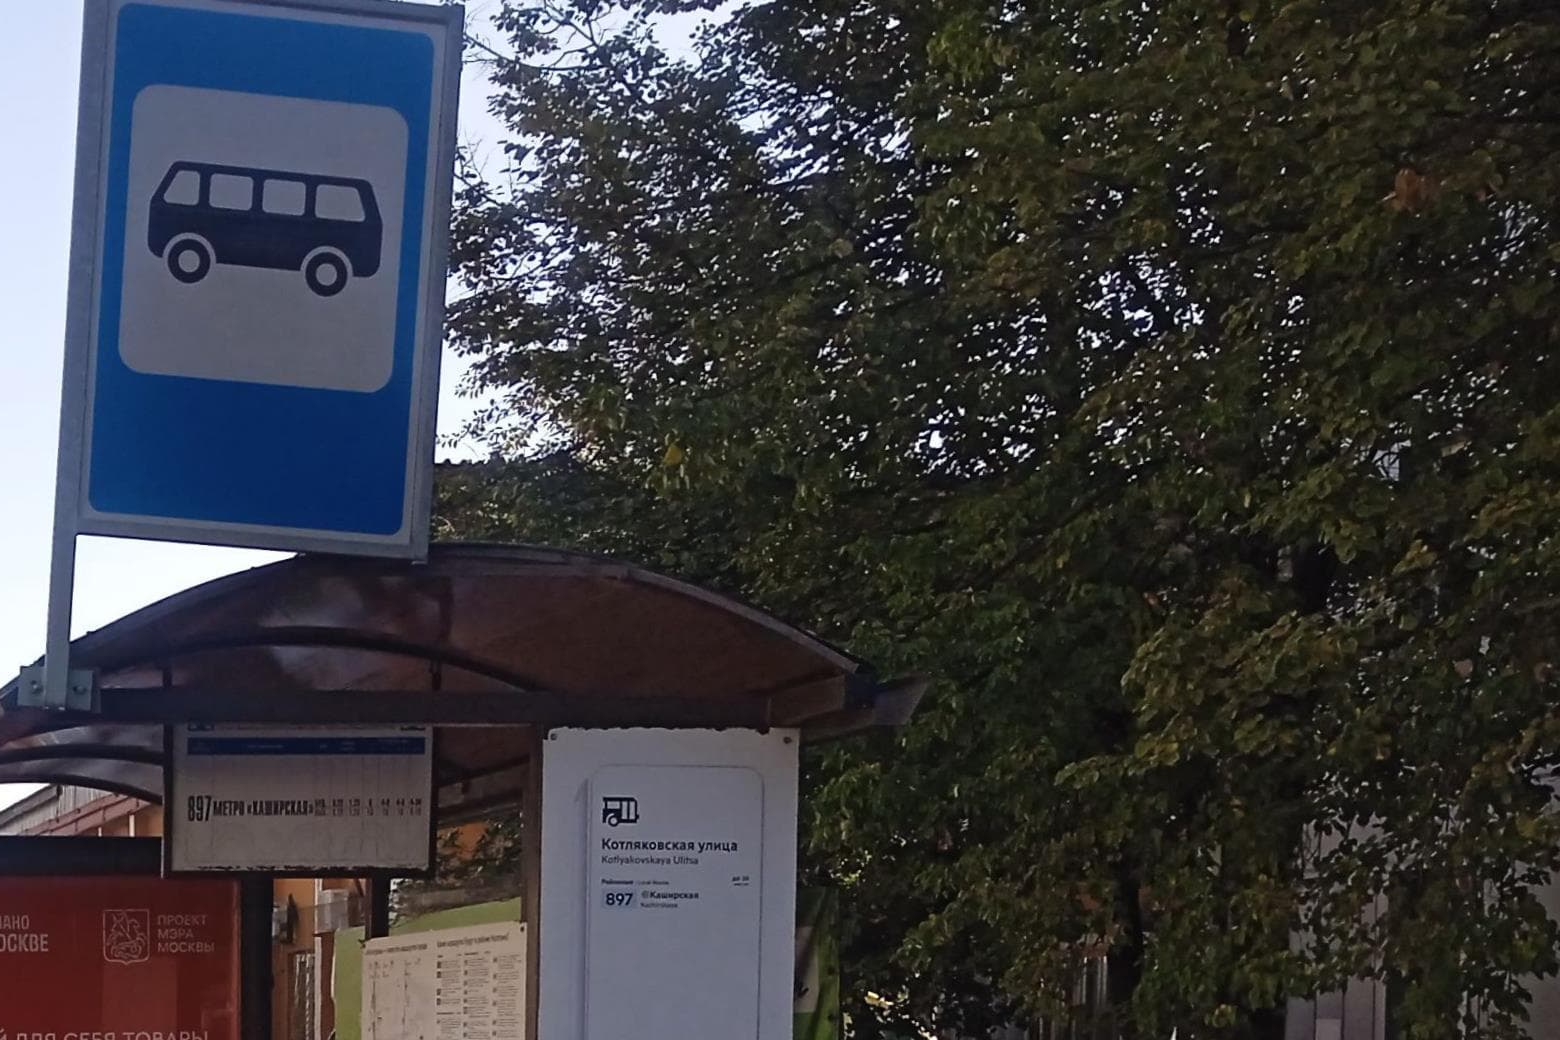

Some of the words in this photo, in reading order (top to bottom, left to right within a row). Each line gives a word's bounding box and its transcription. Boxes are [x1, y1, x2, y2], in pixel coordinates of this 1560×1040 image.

[188, 796, 212, 821] 897
[213, 800, 244, 816] МЕТРО
[601, 838, 695, 851] Котляковская
[698, 840, 738, 853] улица
[601, 855, 671, 866] Kotlyakovskaya
[673, 856, 699, 865] Ulitsa
[606, 892, 634, 907] 897
[650, 891, 699, 901] Каширская
[157, 914, 207, 926] ПРОЕКТ
[157, 928, 194, 940] МЭРА
[157, 940, 215, 953] МОСКВЫ
